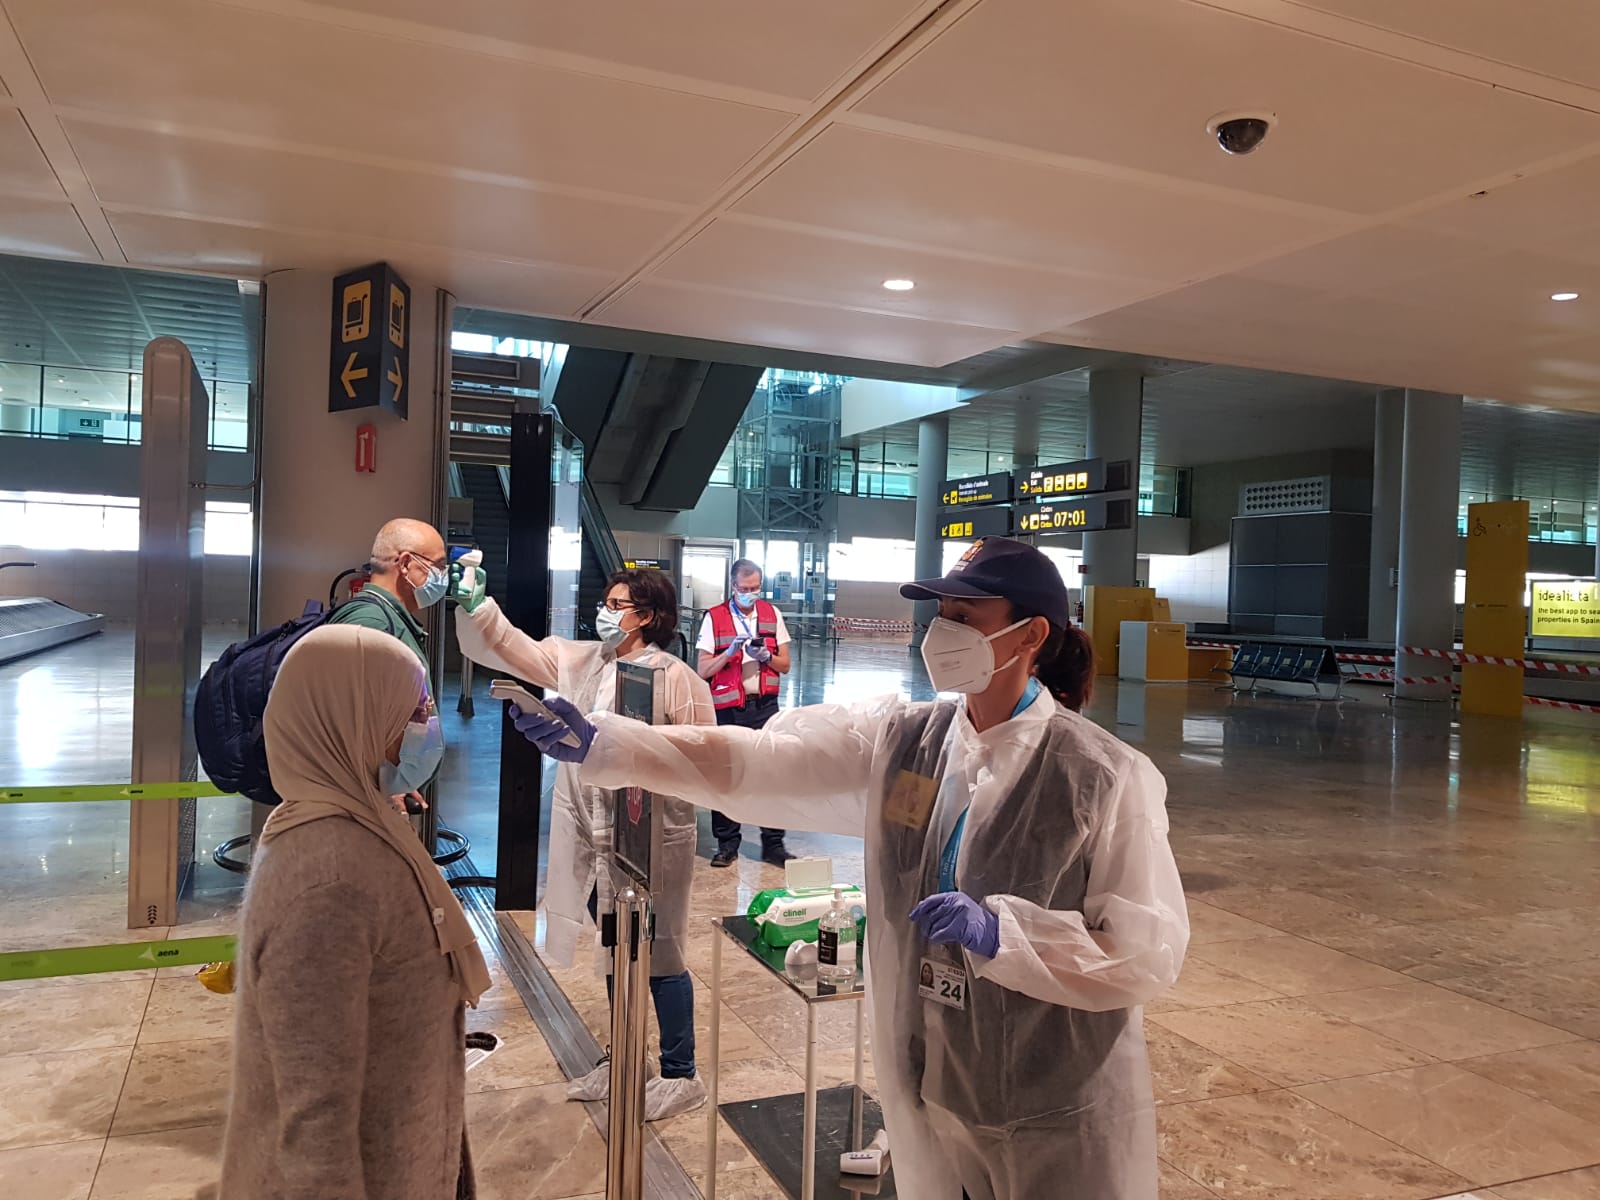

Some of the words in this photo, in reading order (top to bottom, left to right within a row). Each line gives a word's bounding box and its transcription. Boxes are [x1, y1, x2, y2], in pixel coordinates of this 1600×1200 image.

[1566, 608, 1579, 616] app
[1537, 616, 1572, 624] properties
[157, 949, 180, 957] aena
[940, 980, 962, 1002] 24
